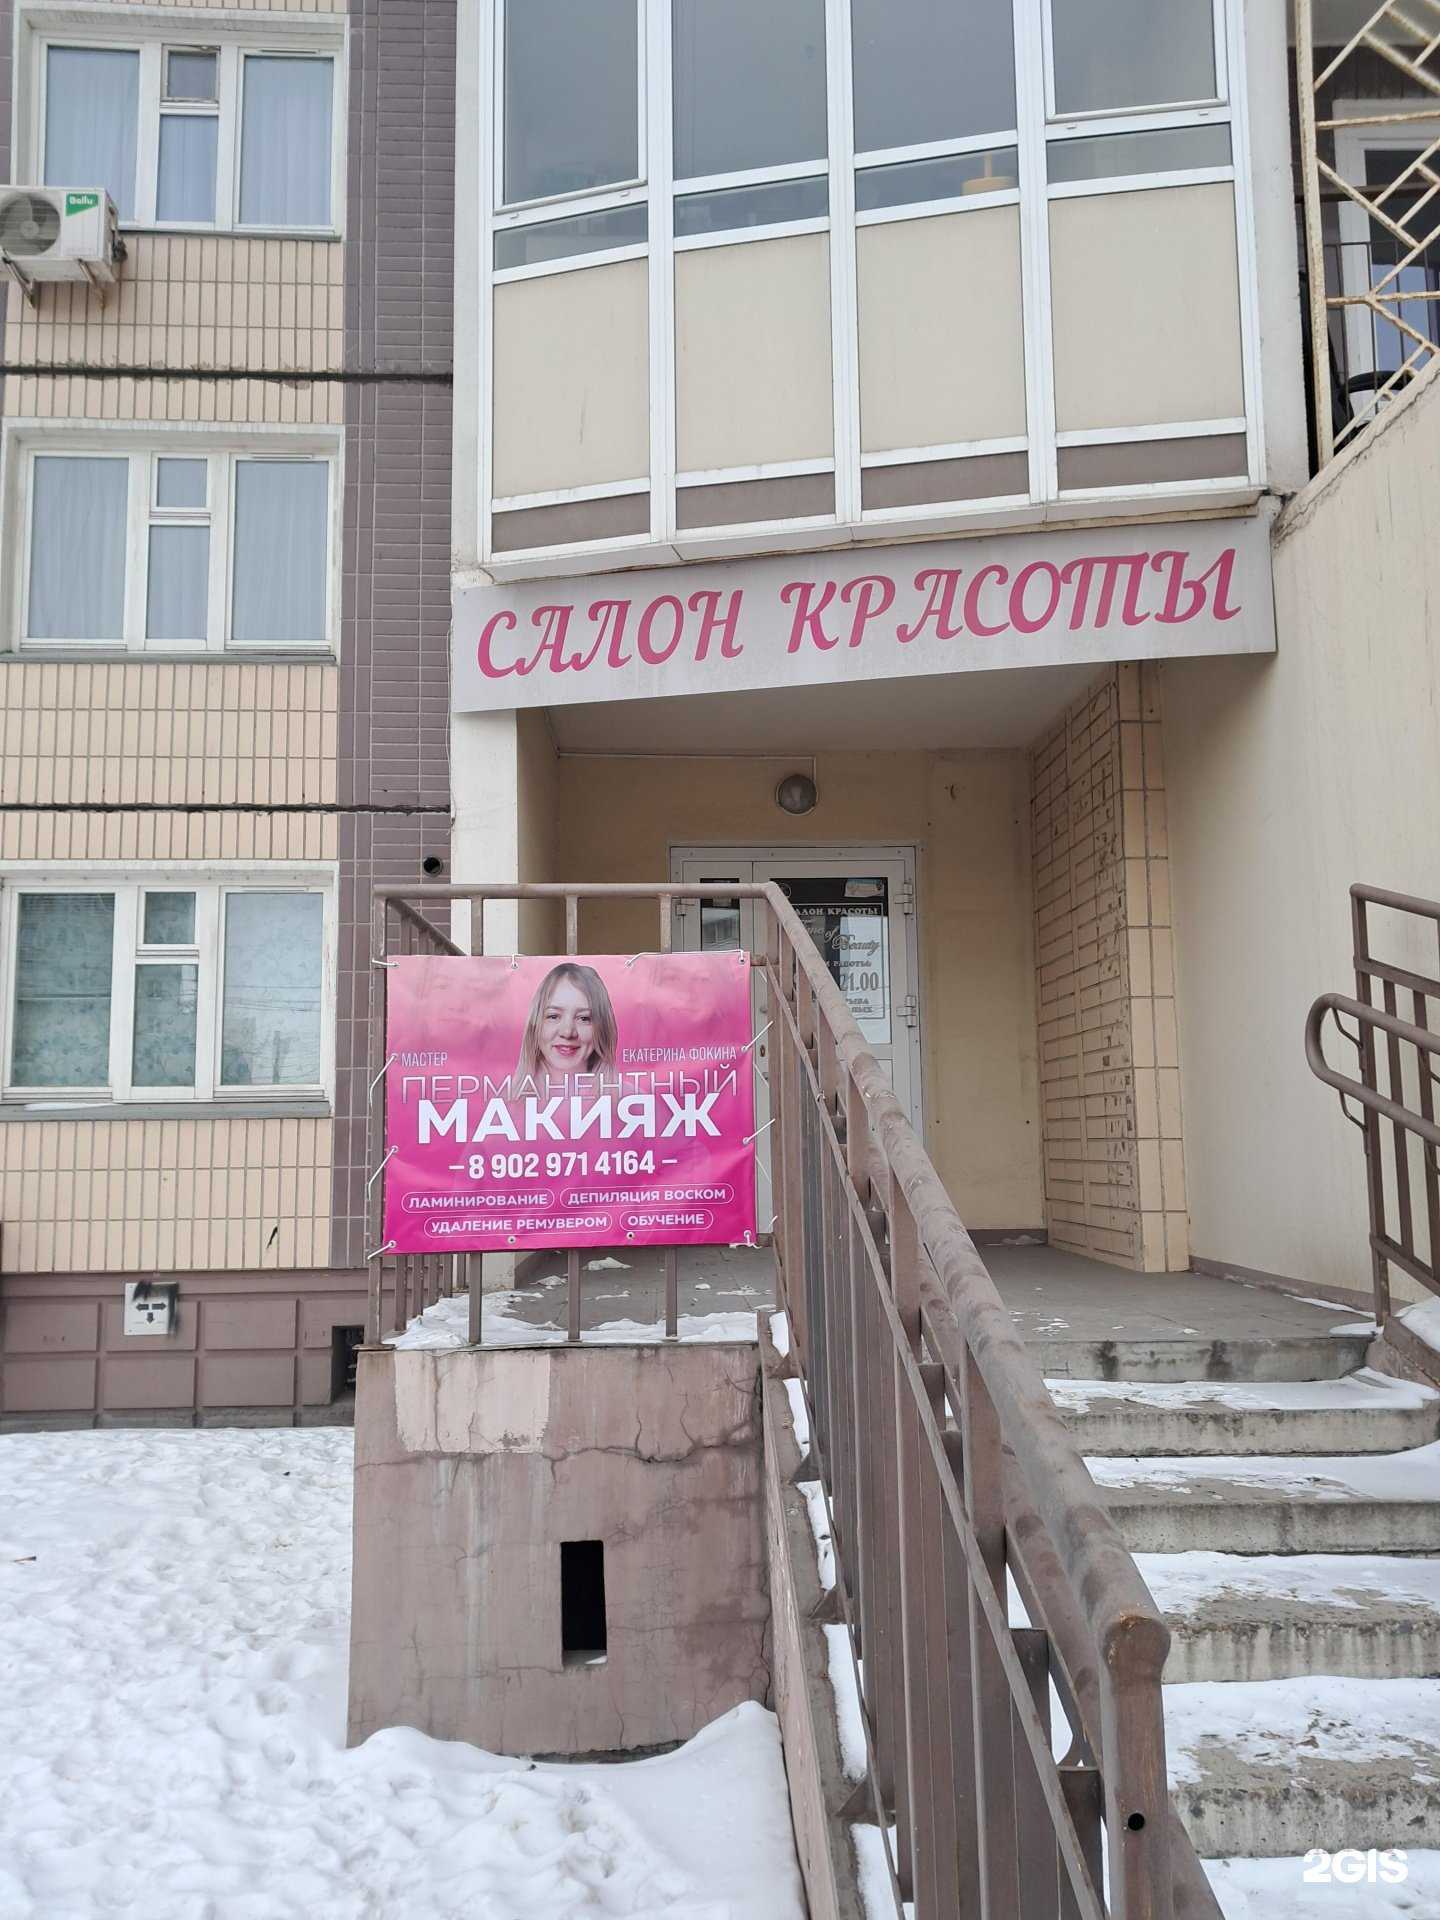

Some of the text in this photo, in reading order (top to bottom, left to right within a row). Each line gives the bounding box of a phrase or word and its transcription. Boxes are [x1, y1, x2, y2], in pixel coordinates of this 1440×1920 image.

[476, 548, 1242, 679] САЛОН КРАСОТЫ
[797, 907, 878, 916] ЛОН КРАСОТЫ
[401, 1046, 737, 1068] МАСТЕР ЕКАТЕРИНА ФОКИНА
[402, 1063, 738, 1104] ПЕРМАНЕНТНЫЙ
[418, 1092, 722, 1144] МАКИЯЖ
[491, 1153, 540, 1178] 902
[545, 1151, 588, 1177] 971
[594, 1150, 656, 1175] 4164
[408, 1193, 548, 1209] ЛАМИНИРОВАНИЕ
[567, 1188, 726, 1205] ДЕПИЛЯЦИЯ ВОСКОМ
[431, 1216, 608, 1234] УДАЛЕНИЕ РЕМУВЕРОМ
[627, 1213, 705, 1227] ОБУЧЕНИЕ
